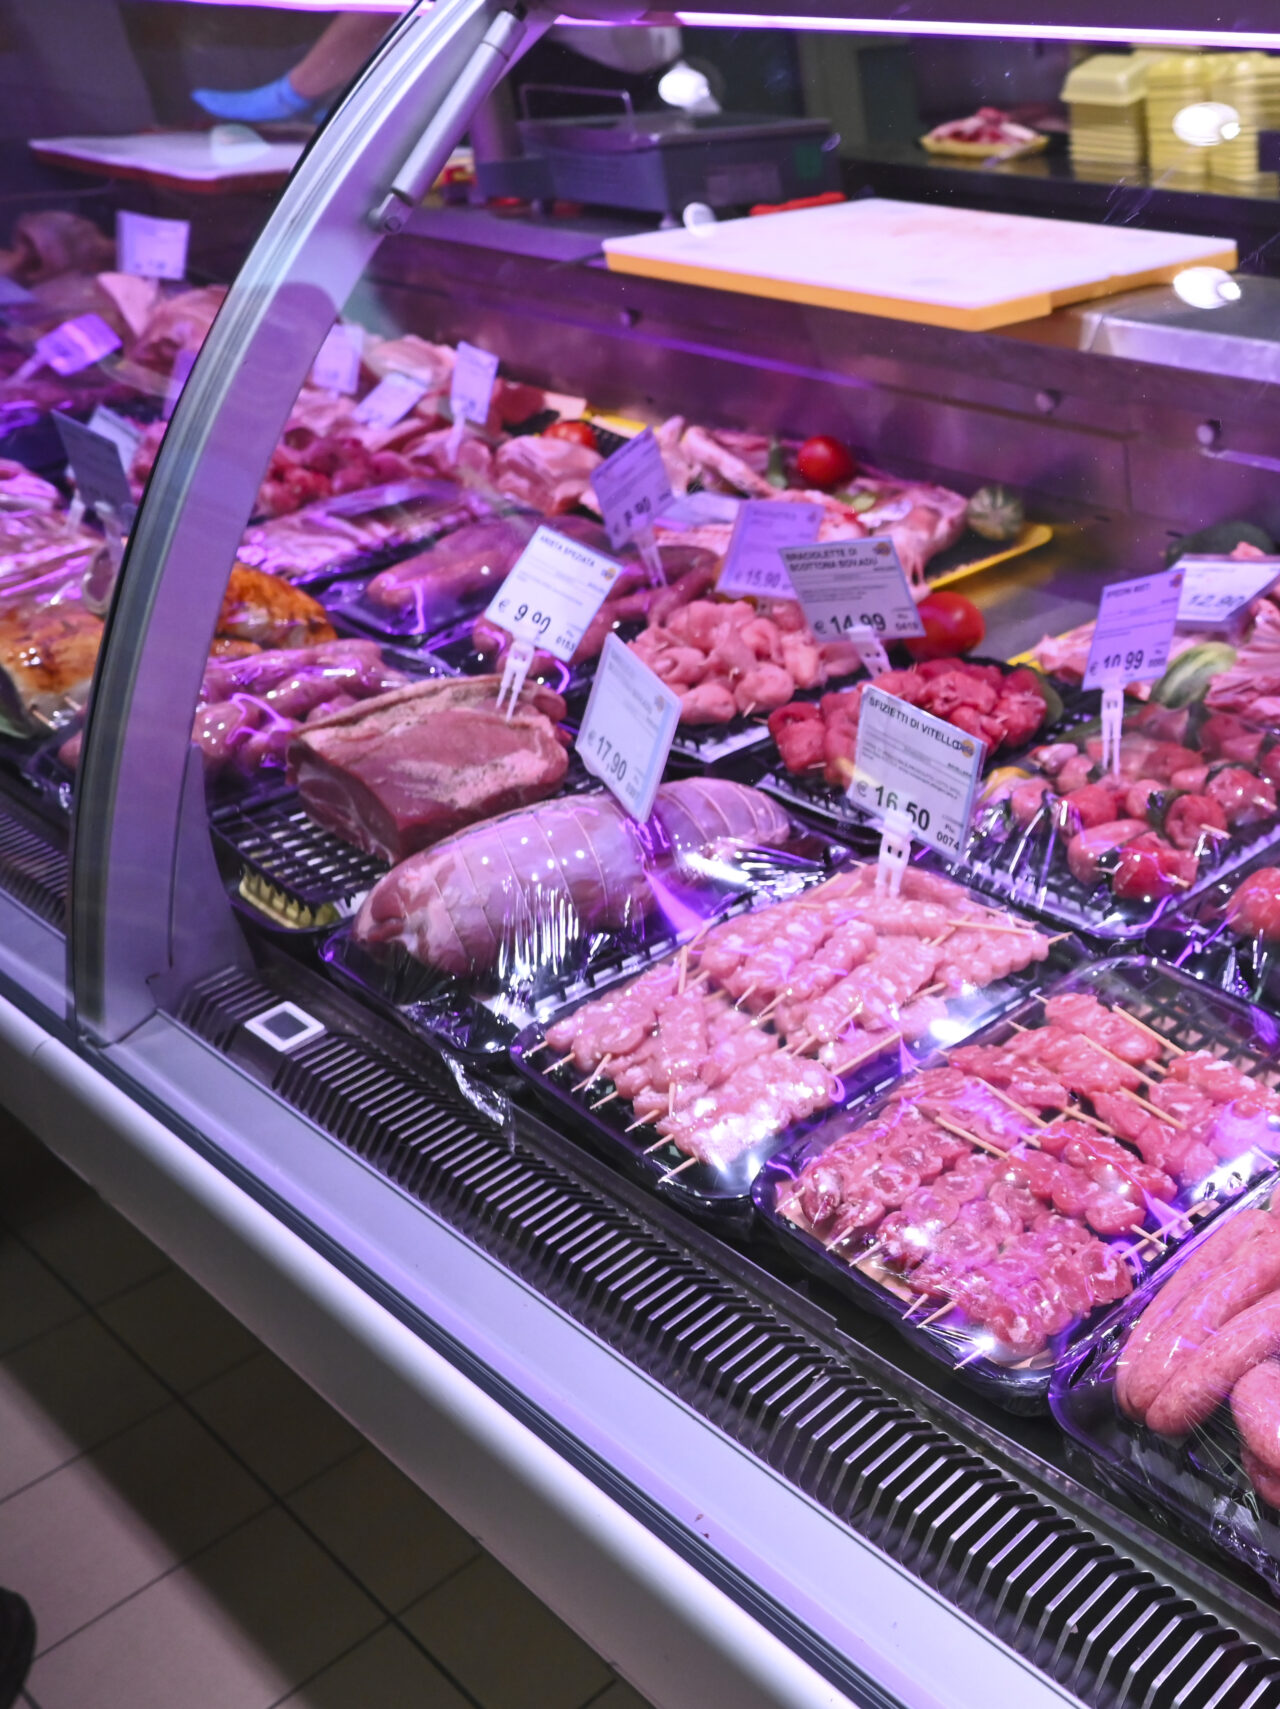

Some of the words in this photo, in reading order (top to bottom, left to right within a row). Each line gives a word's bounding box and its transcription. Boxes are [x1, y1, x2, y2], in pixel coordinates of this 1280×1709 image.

[829, 611, 887, 634] 1499
[1103, 648, 1144, 670] 1099
[868, 696, 908, 723] SFIZIETTI
[910, 717, 919, 729] DI
[875, 785, 930, 831] 1650
[936, 831, 960, 851] 0074
